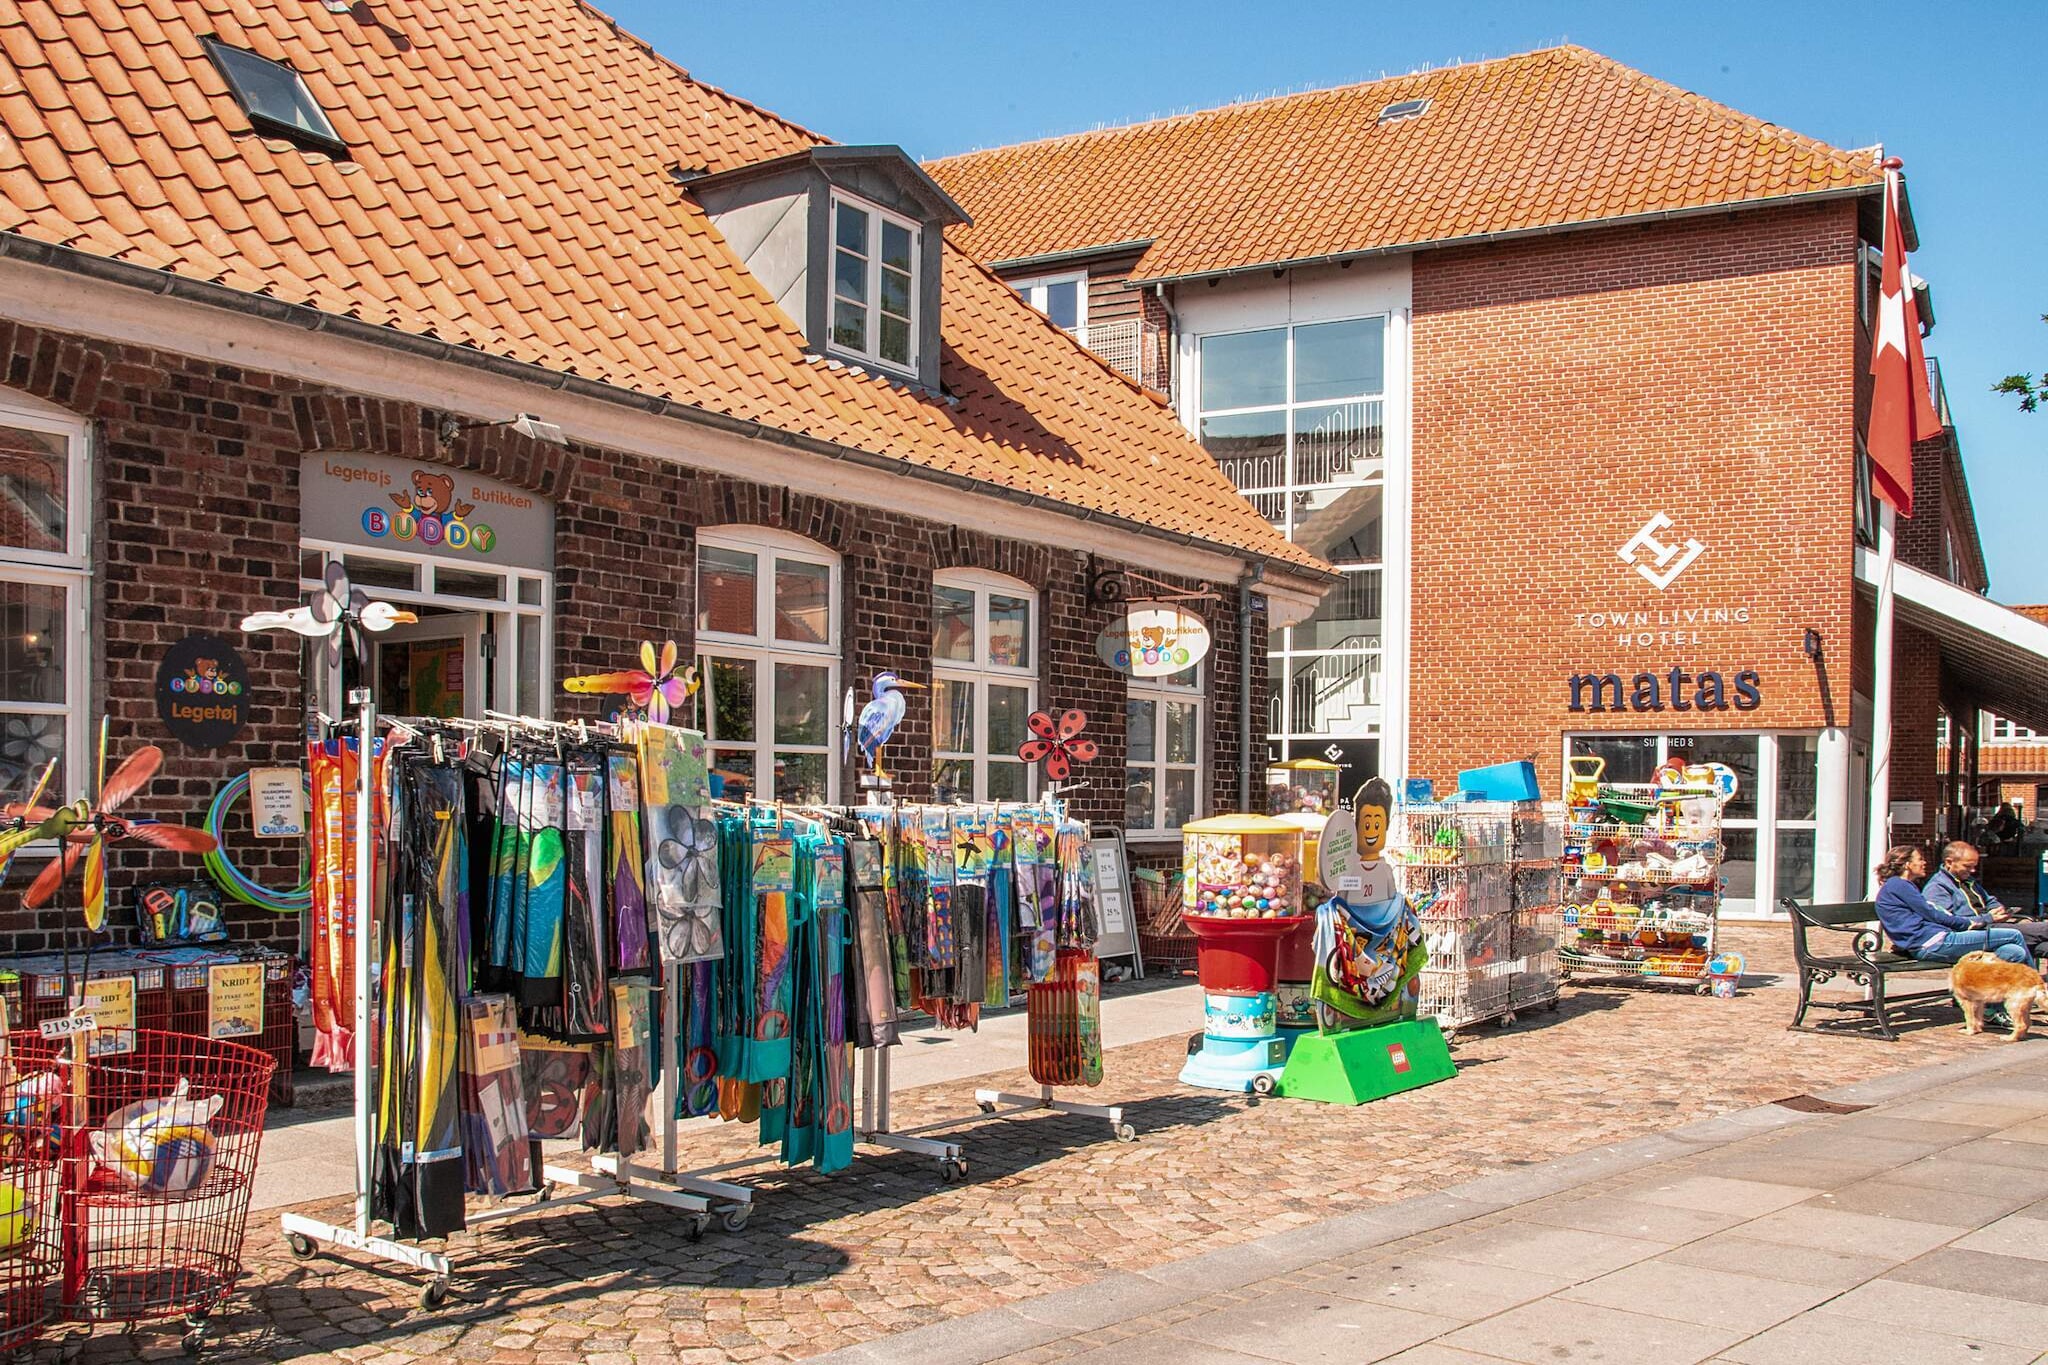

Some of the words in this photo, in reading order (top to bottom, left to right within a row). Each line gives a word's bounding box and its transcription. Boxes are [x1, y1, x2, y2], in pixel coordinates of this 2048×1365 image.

[324, 460, 392, 488] Legetøjs
[471, 486, 532, 509] Butikken
[365, 509, 494, 551] BUDDY
[1574, 611, 1648, 628] TOWN
[1658, 607, 1750, 624] LIVING
[1166, 626, 1203, 636] Butikken
[1618, 631, 1703, 647] HOTEL
[171, 678, 241, 694] BUDDY
[1568, 666, 1762, 713] matas
[172, 702, 238, 724] Legetøj
[1643, 737, 1686, 748] SUHED
[1363, 884, 1373, 897] 20
[221, 978, 250, 987] KRIDT
[43, 1016, 93, 1036] 219.95
